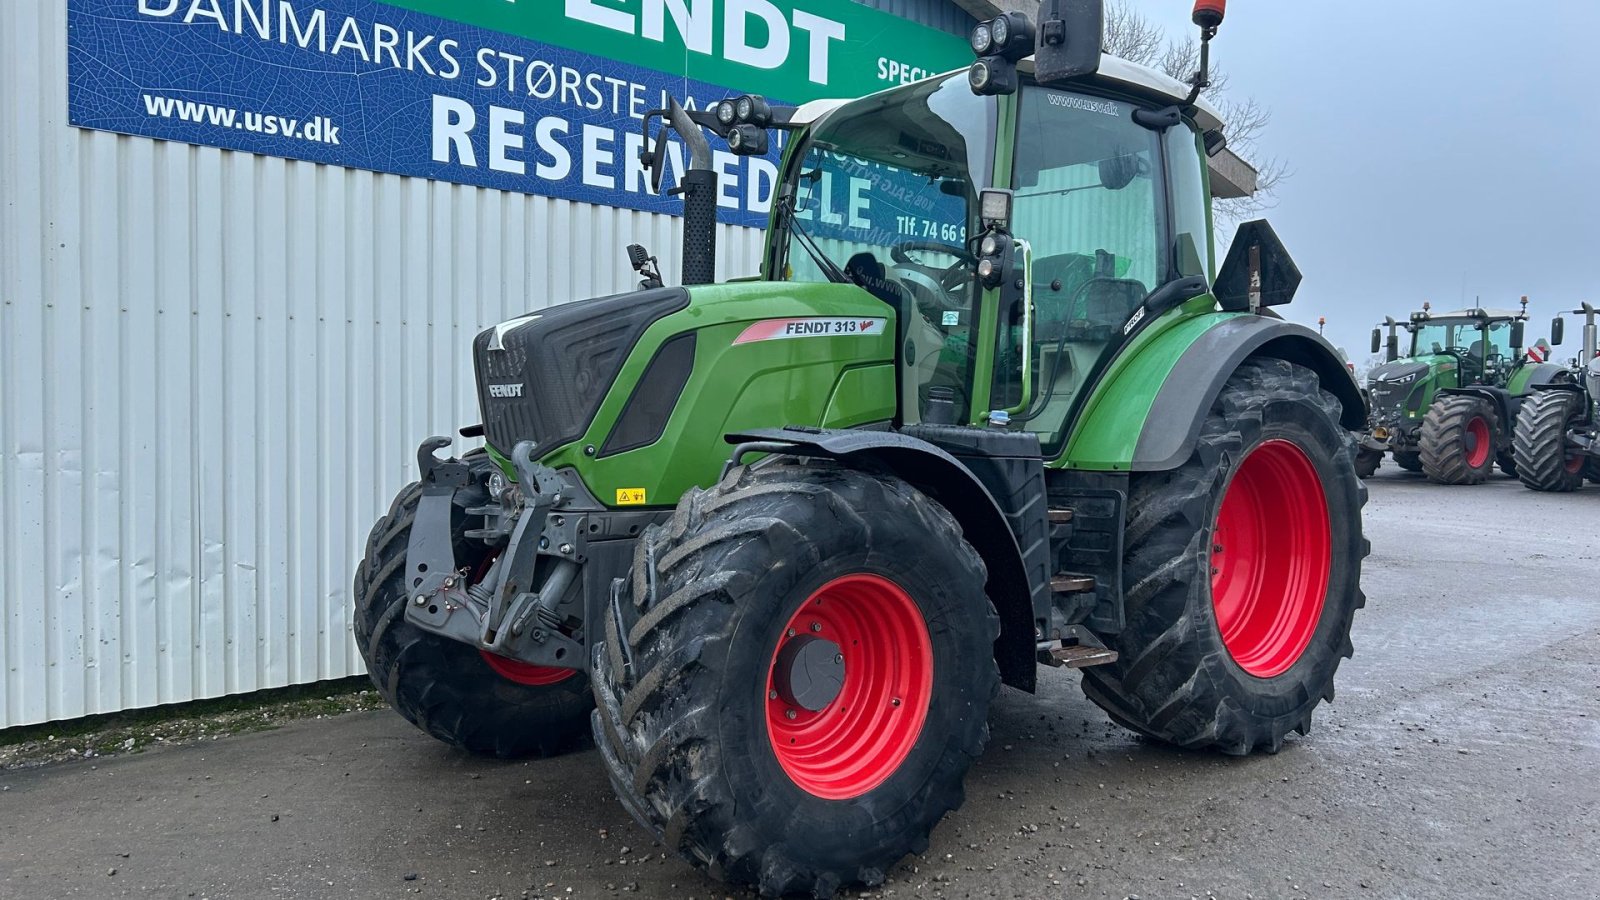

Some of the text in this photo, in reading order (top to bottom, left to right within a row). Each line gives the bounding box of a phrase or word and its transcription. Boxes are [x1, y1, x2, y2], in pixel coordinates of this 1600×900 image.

[477, 48, 646, 119] STØRSTE
[1047, 93, 1119, 117] www.usv.dk
[143, 94, 339, 145] www.usv.dk
[896, 215, 918, 236] Tlf.
[922, 219, 938, 239] 74
[941, 223, 957, 242] 66
[786, 322, 831, 334] FENDT
[834, 321, 856, 332] 313
[488, 382, 524, 397] FENDT
